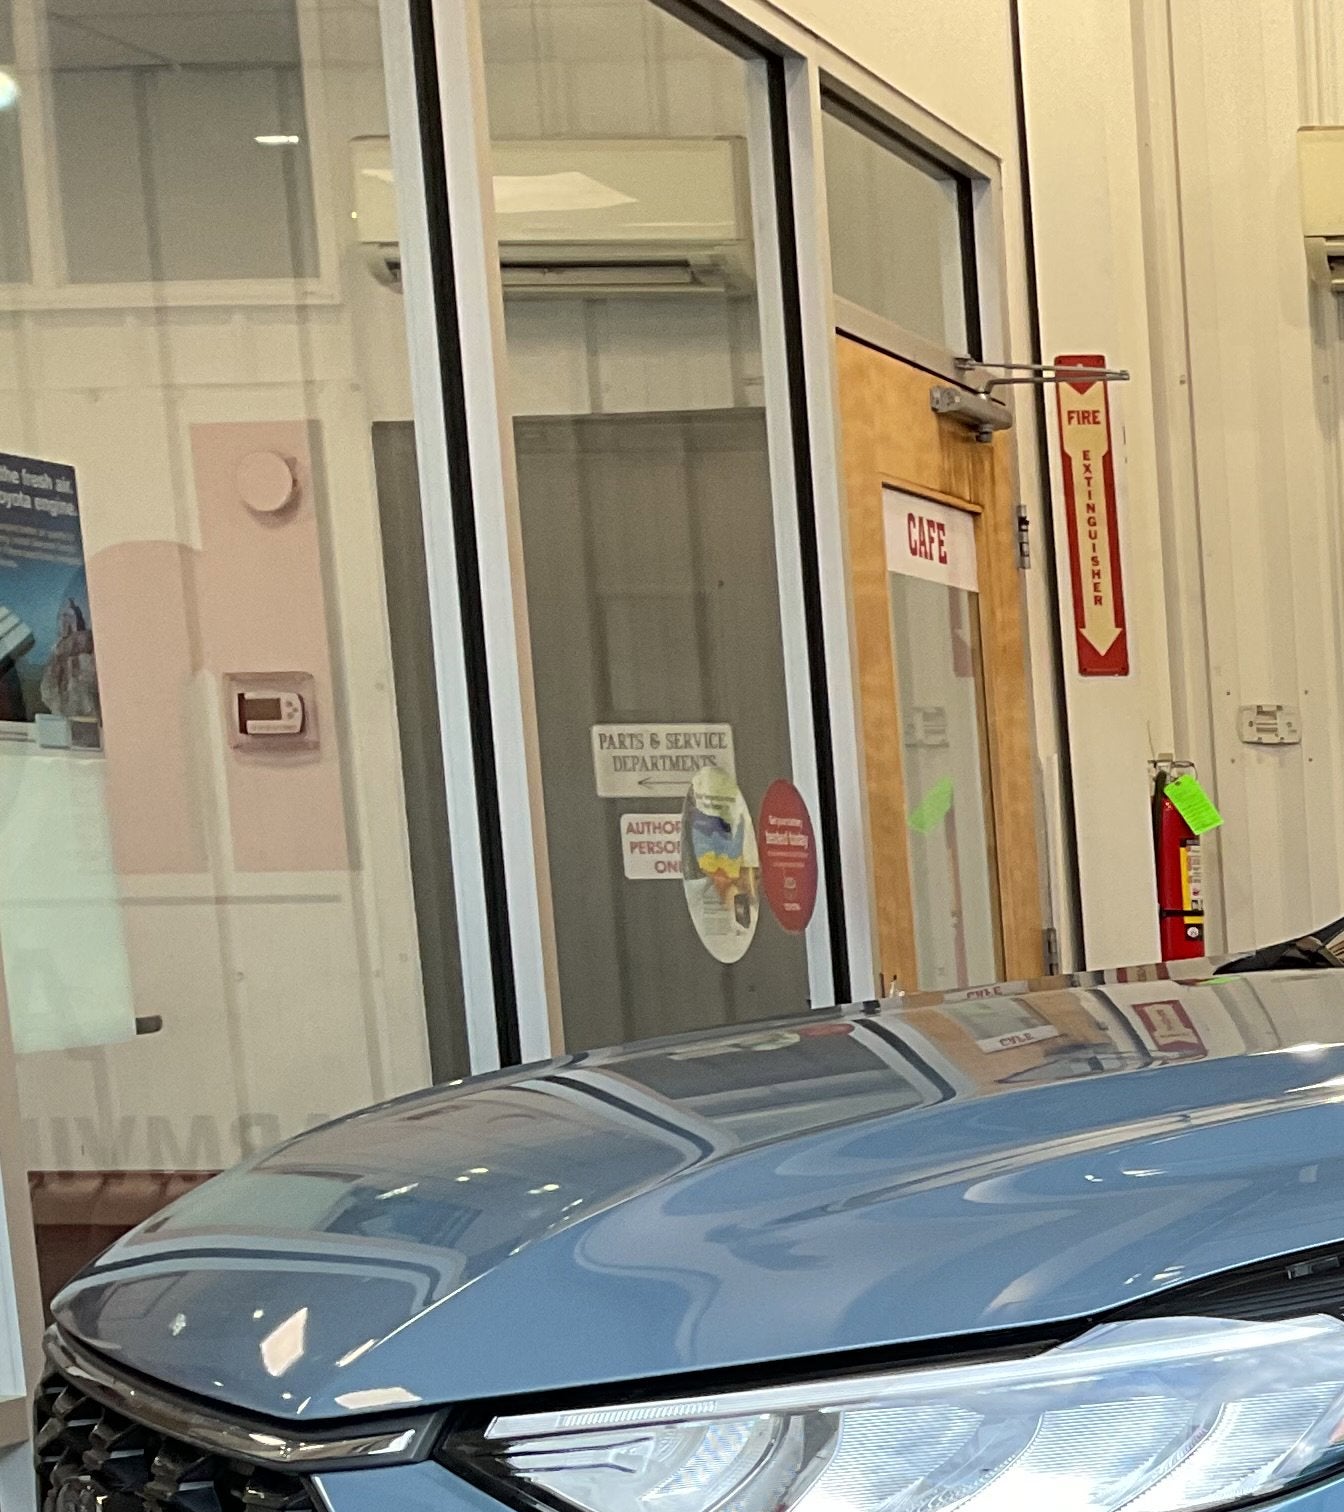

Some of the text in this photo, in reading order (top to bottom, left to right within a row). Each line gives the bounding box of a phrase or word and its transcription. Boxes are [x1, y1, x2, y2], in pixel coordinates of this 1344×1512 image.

[1067, 410, 1101, 425] FIRE
[907, 513, 948, 565] CAFE
[1082, 450, 1103, 606] EXTINGUISHER
[598, 732, 728, 750] PARTS & SERVICE
